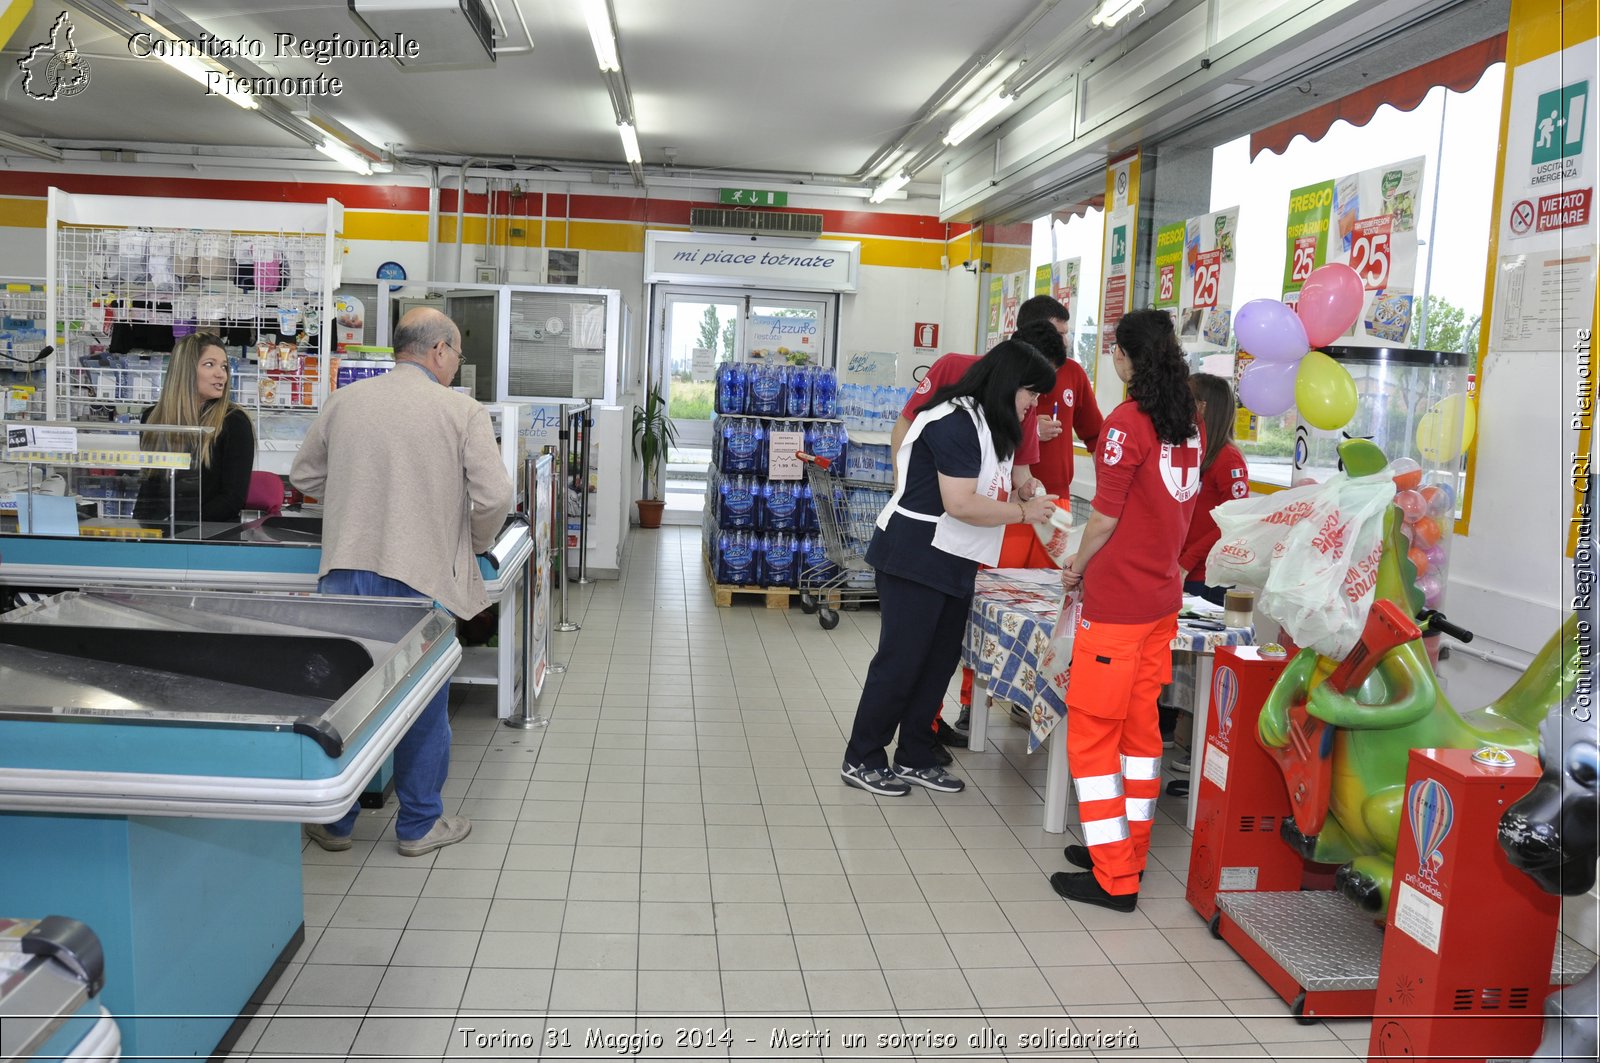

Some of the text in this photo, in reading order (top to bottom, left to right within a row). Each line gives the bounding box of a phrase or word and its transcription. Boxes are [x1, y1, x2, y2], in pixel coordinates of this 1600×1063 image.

[1537, 159, 1574, 174] USCITA DI
[1531, 168, 1577, 185] EMERGENZA
[1289, 187, 1332, 215] FRESCO
[1541, 192, 1585, 213] VIETATO
[1539, 208, 1585, 228] FUMARE
[1157, 226, 1185, 248] FRESCO
[1287, 218, 1329, 239] RISPARMIO
[673, 249, 835, 268] mi piace tornare
[1155, 250, 1183, 267] RISPARMIO
[1221, 544, 1250, 560] SELEX
